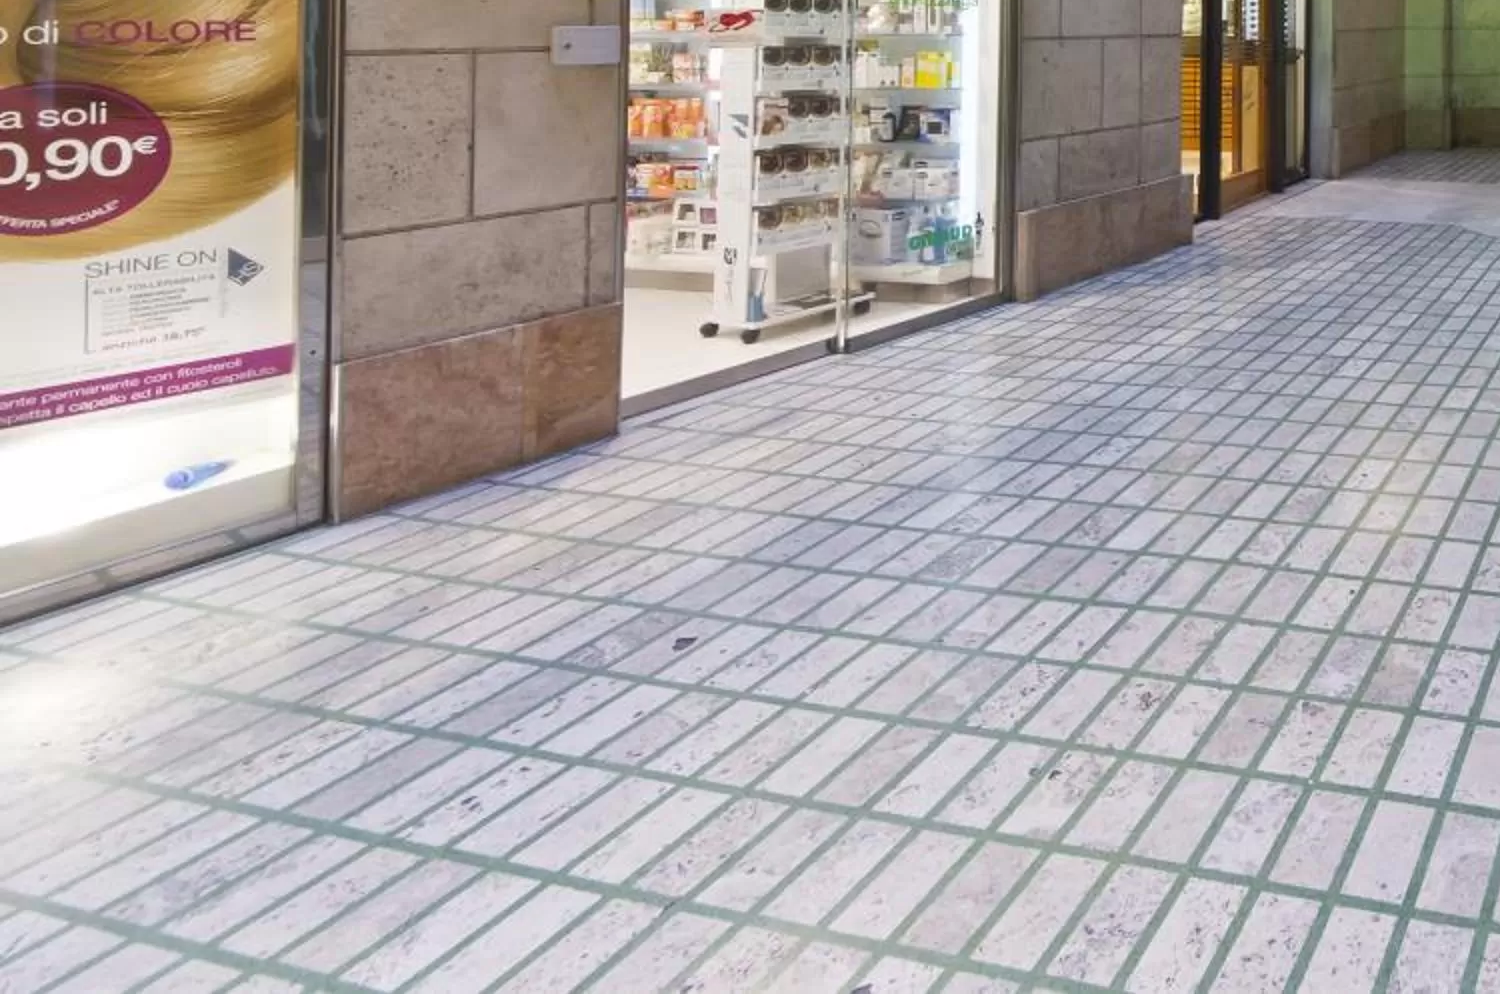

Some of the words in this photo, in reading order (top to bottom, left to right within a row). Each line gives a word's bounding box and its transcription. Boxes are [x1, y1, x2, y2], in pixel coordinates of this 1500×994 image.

[22, 19, 60, 45] di
[73, 19, 257, 46] COLORE
[0, 110, 24, 129] a
[36, 101, 108, 127] soli
[84, 253, 170, 279] SHINE
[176, 247, 217, 268] ON
[143, 372, 173, 386] con
[130, 386, 152, 401] ed
[155, 385, 164, 396] il
